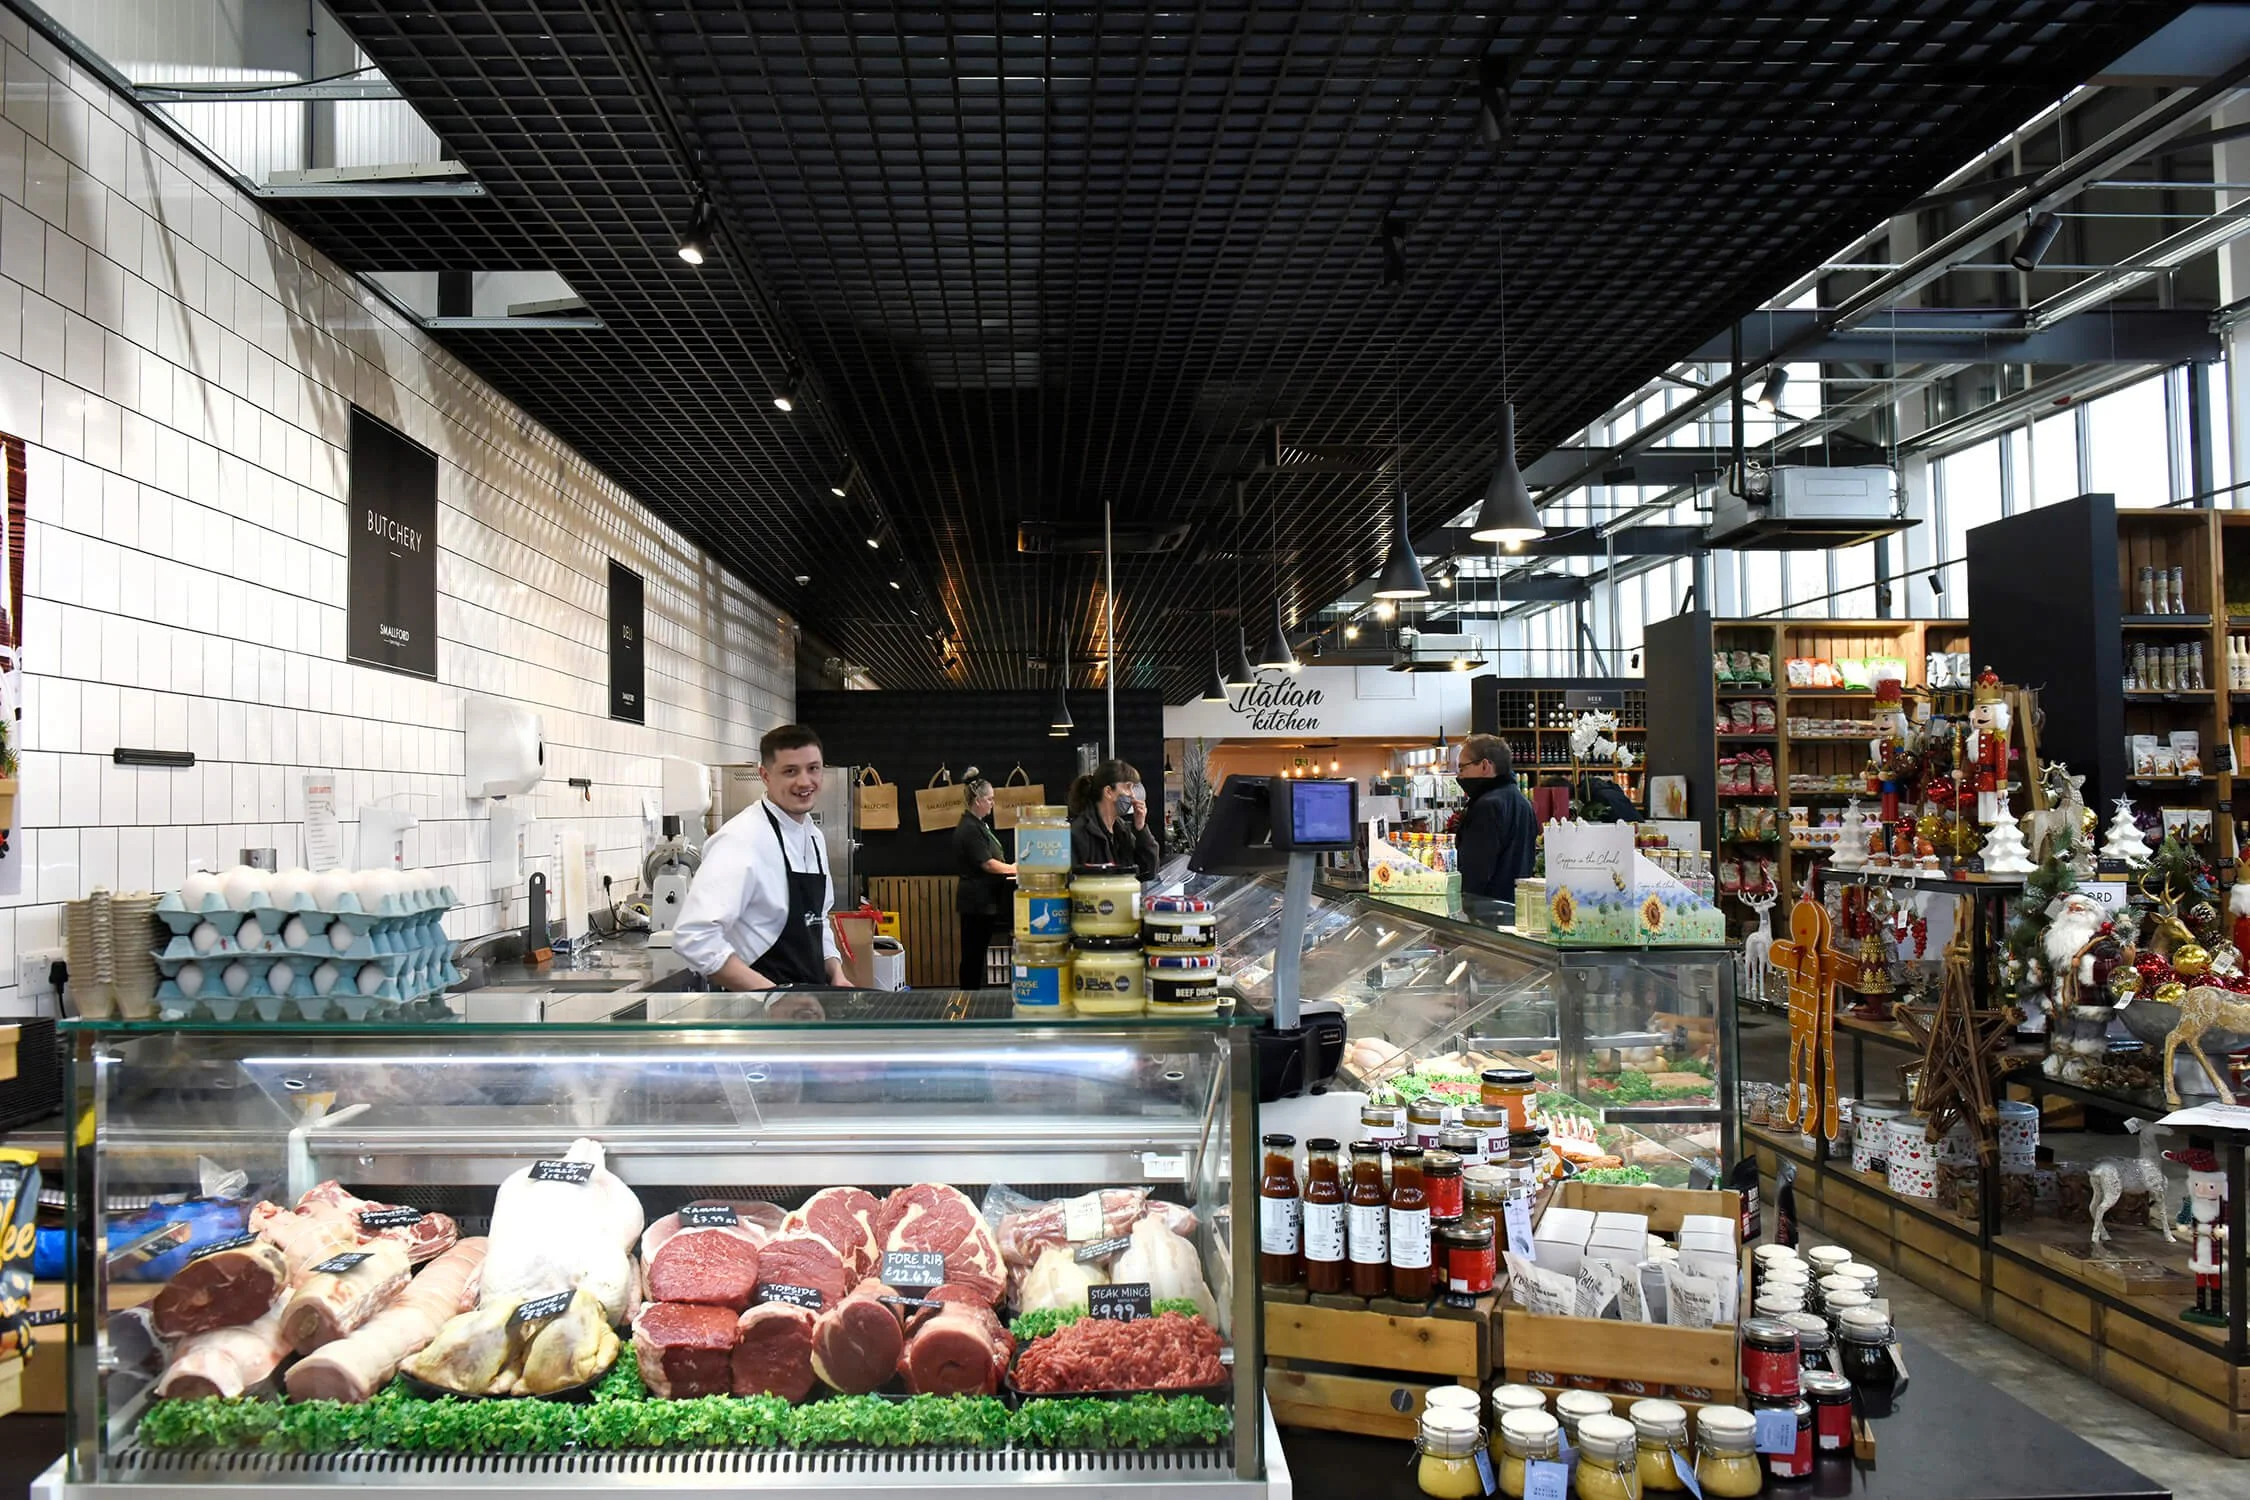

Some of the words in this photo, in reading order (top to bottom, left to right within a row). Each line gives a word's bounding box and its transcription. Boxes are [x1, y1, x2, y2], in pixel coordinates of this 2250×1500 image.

[366, 509, 423, 553] BUTCHERY
[380, 623, 410, 642] SMALLFORD
[1229, 667, 1325, 713] Italian
[1246, 708, 1321, 731] kitchen
[1154, 933, 1171, 942] BEEF
[1172, 933, 1207, 943] DRIPPING
[1175, 988, 1195, 997] BEEF
[888, 1253, 920, 1265] FORE
[923, 1254, 943, 1266] RIB
[768, 1284, 817, 1296] TOPSIDE
[1091, 1288, 1119, 1300] STEAK
[1121, 1287, 1151, 1298] MINCE
